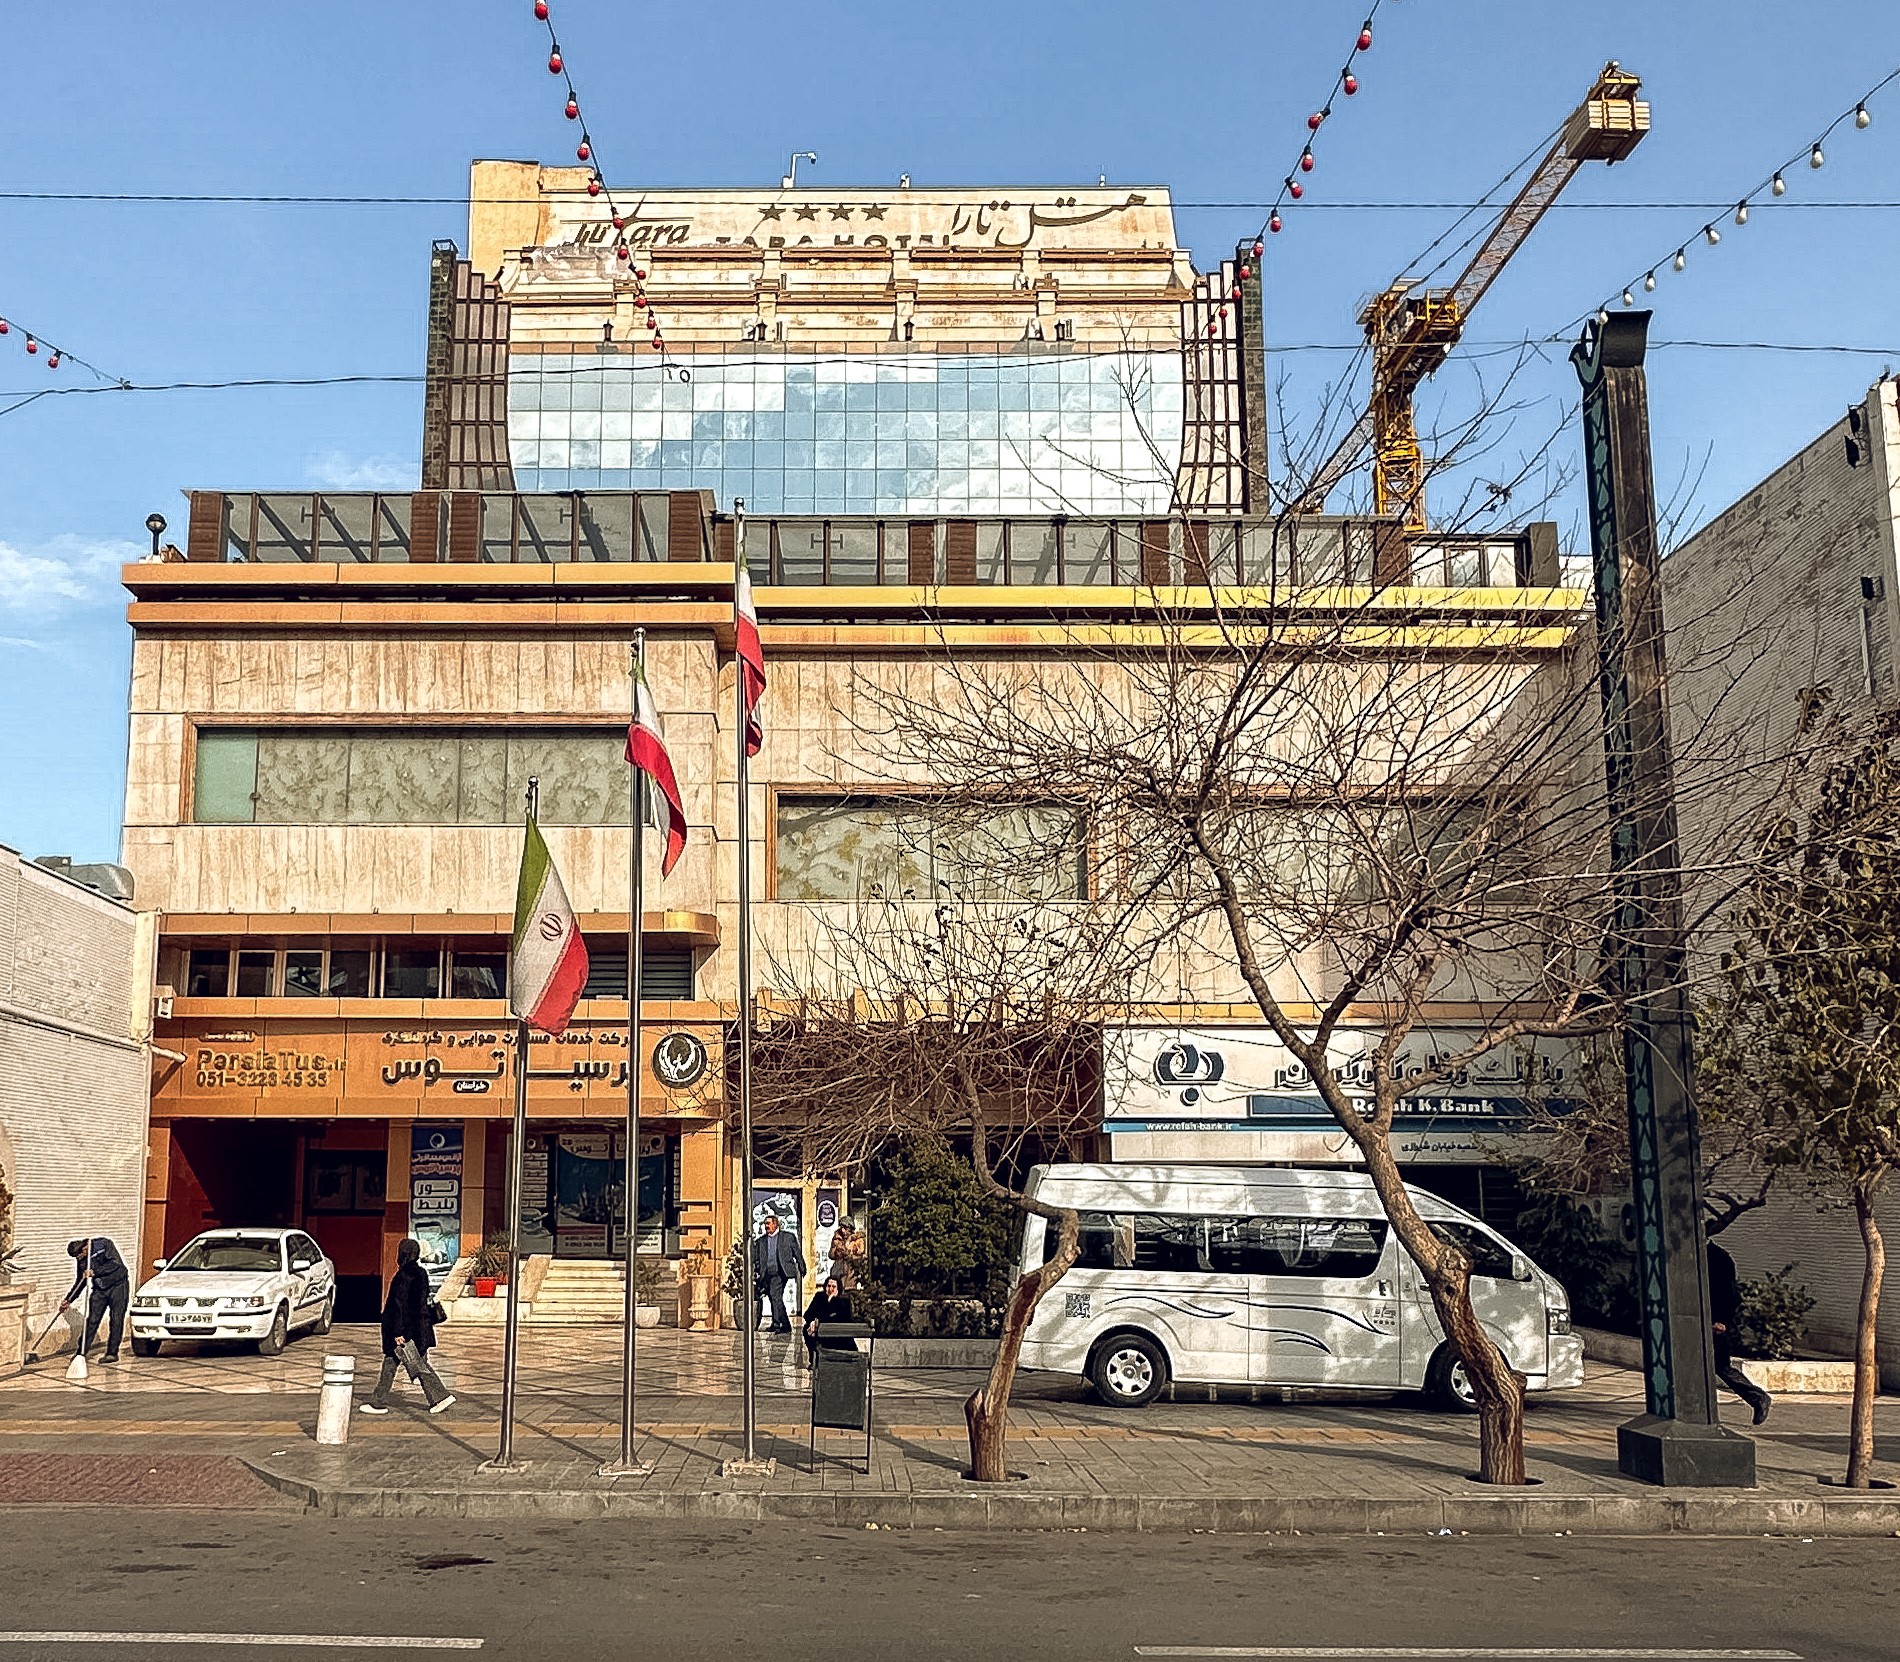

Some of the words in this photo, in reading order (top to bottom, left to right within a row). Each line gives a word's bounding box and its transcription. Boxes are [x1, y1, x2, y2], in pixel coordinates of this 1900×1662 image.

[951, 200, 1010, 236] تارا
[995, 193, 1146, 248] هتل
[447, 1035, 456, 1047] و
[459, 1031, 497, 1048] هوایی
[502, 1031, 551, 1047] مسارت
[599, 1032, 629, 1048] رکت
[382, 1051, 505, 1086] توس
[1352, 1098, 1412, 1112] Reah
[1418, 1098, 1438, 1112] K.
[1440, 1098, 1495, 1114] Bank
[418, 1180, 455, 1195] تور
[417, 1197, 455, 1213] بلیط
